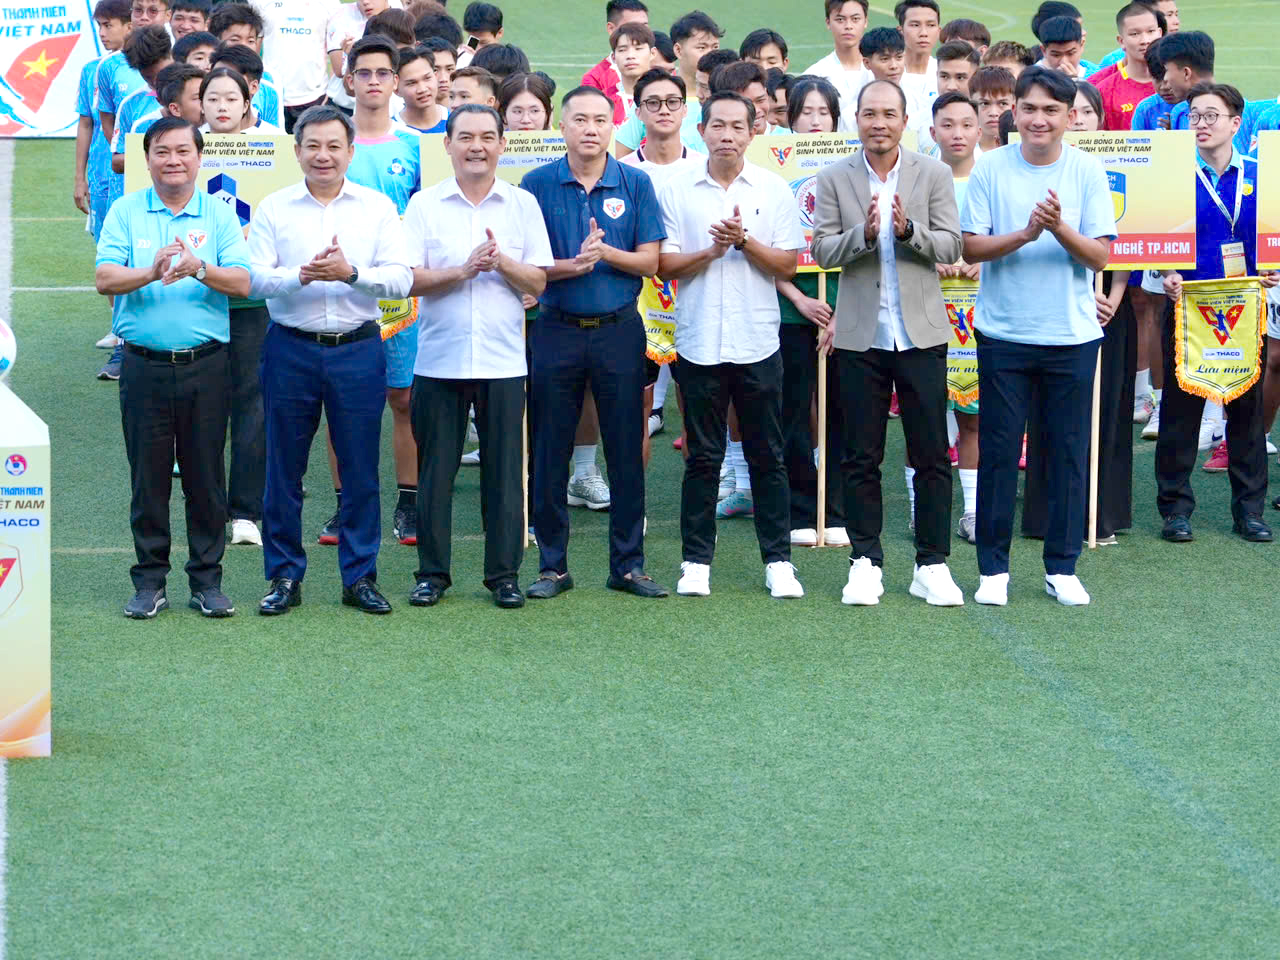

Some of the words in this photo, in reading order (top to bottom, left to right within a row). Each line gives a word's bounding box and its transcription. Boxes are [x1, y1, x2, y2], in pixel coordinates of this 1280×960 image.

[40, 20, 82, 35] NAM
[280, 27, 312, 35] THACO
[1113, 240, 1144, 257] NGHỆ
[1147, 241, 1191, 255] TP.HCM
[14, 499, 45, 510] NAM
